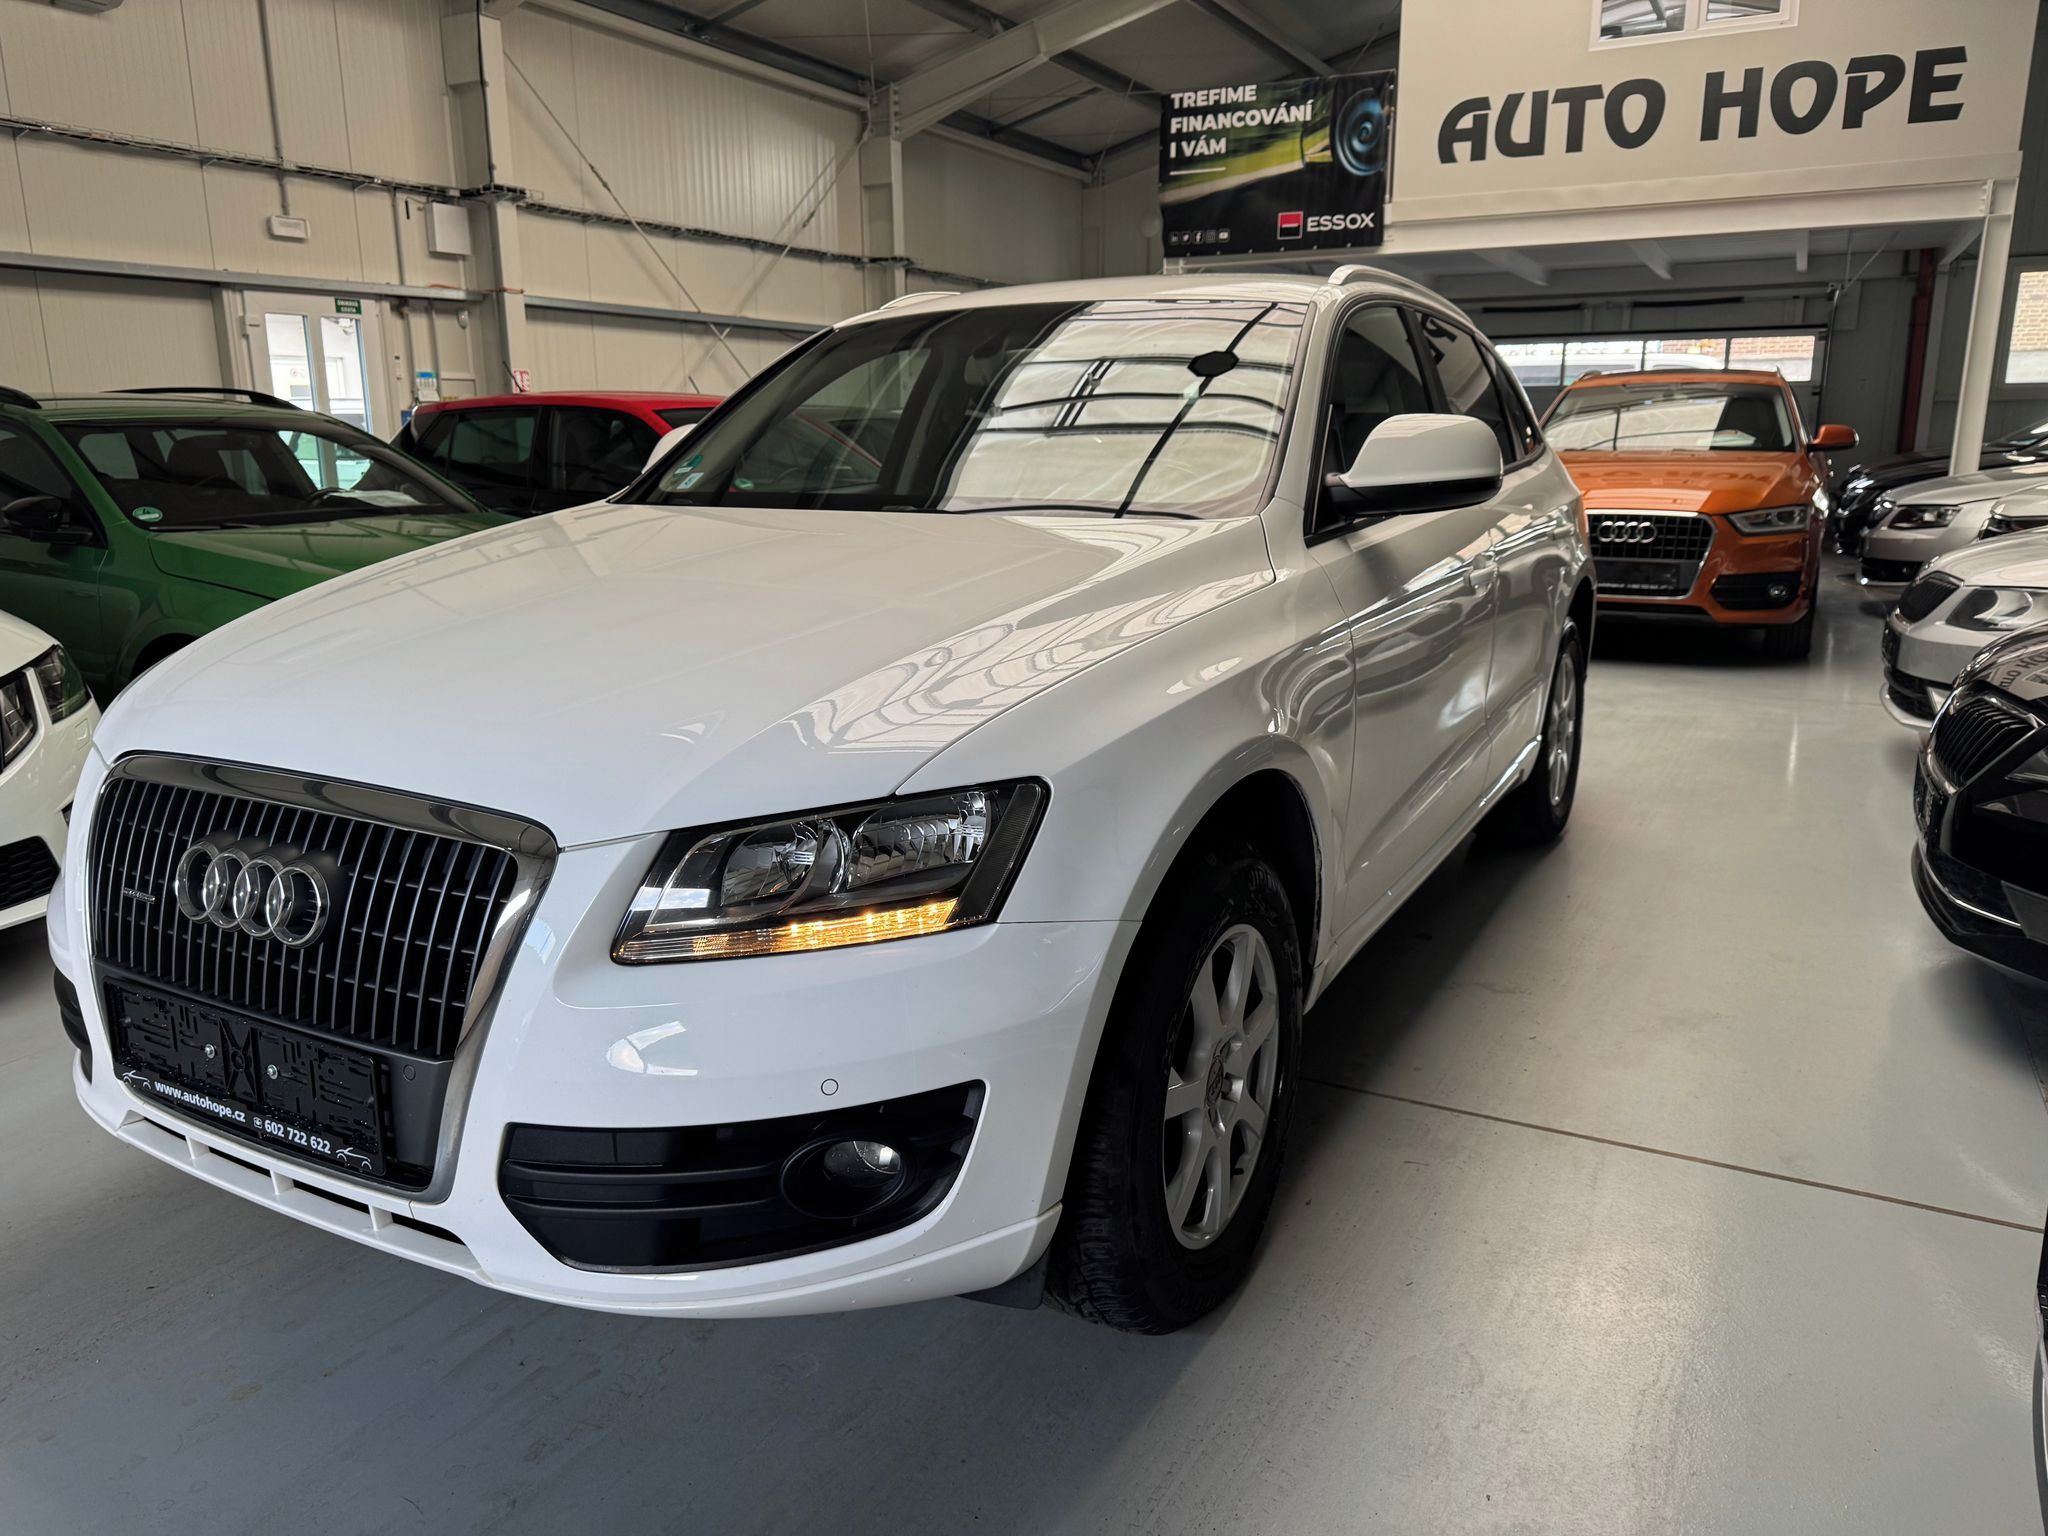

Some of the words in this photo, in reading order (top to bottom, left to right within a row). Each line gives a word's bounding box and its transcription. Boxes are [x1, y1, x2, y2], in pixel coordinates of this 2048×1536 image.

[1170, 84, 1257, 109] TREFIME
[1437, 78, 1666, 164] AUTO
[1699, 46, 1968, 143] HOPE
[1169, 99, 1314, 134] FINANCOVÁNÍ
[1169, 141, 1177, 158] I
[1181, 135, 1227, 158] VÁM
[1306, 212, 1375, 232] ESSOX
[154, 1080, 246, 1123] www.autohope.cz
[264, 1119, 285, 1137] 602
[287, 1126, 307, 1146] 722
[310, 1134, 331, 1154] 622
